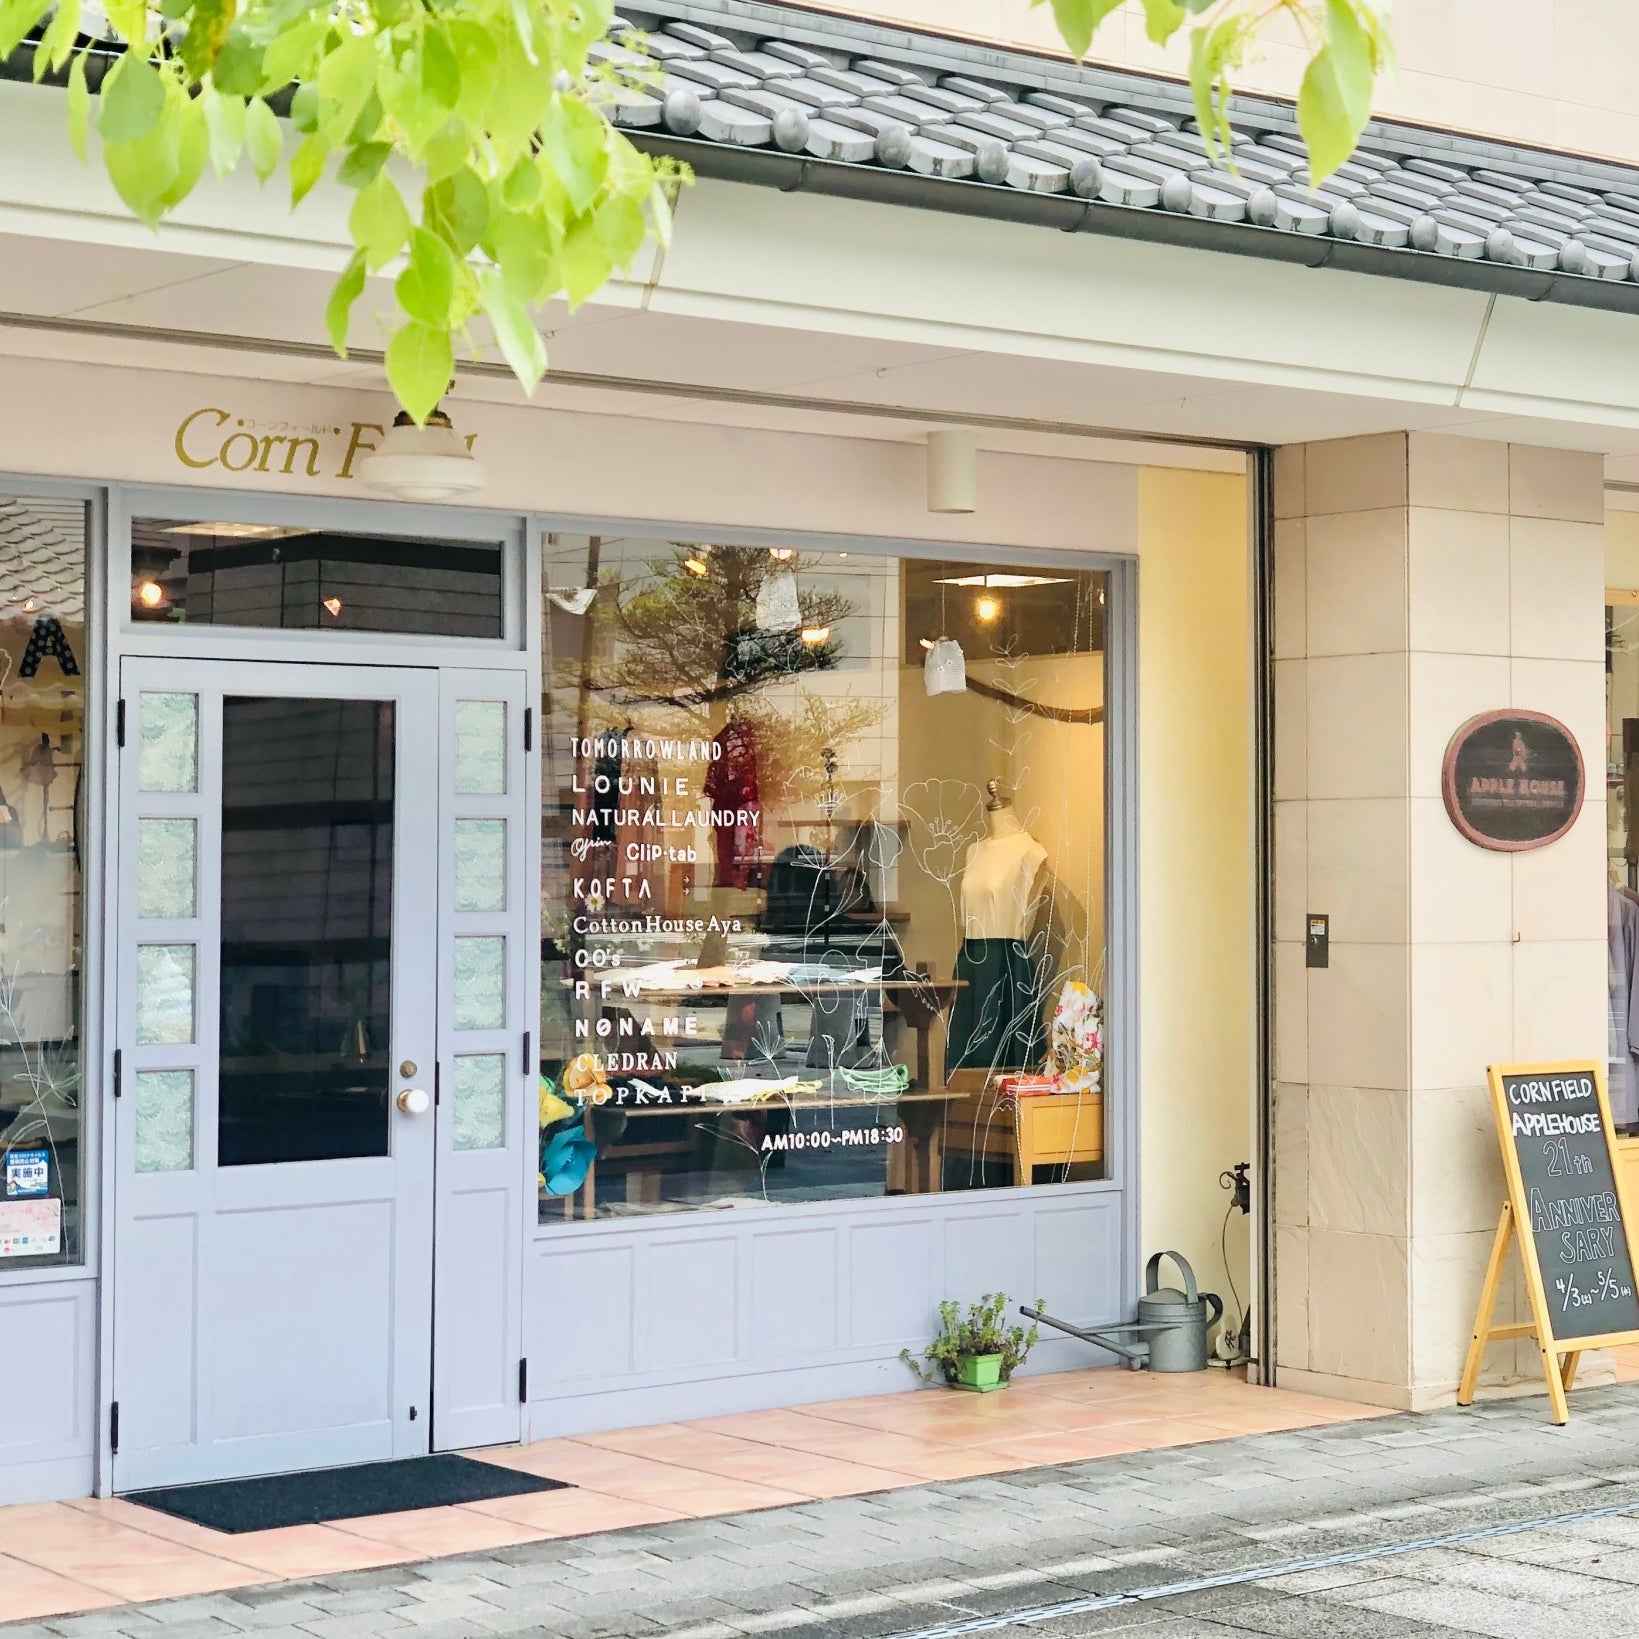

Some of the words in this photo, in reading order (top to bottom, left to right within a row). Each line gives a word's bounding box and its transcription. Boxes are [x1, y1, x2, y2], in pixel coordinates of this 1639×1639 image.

[174, 407, 321, 477] Corn
[570, 737, 722, 761] TOMORROWLAND
[572, 775, 689, 796] LOUNIE
[572, 809, 666, 827] NATURAL
[671, 810, 760, 828] LAUNDRY
[707, 915, 742, 938] Aya
[575, 979, 641, 1000] RFW
[576, 1051, 678, 1073] CLEDRAN
[573, 1085, 707, 1107] TOPKAPI
[1560, 1226, 1615, 1264] SARY
